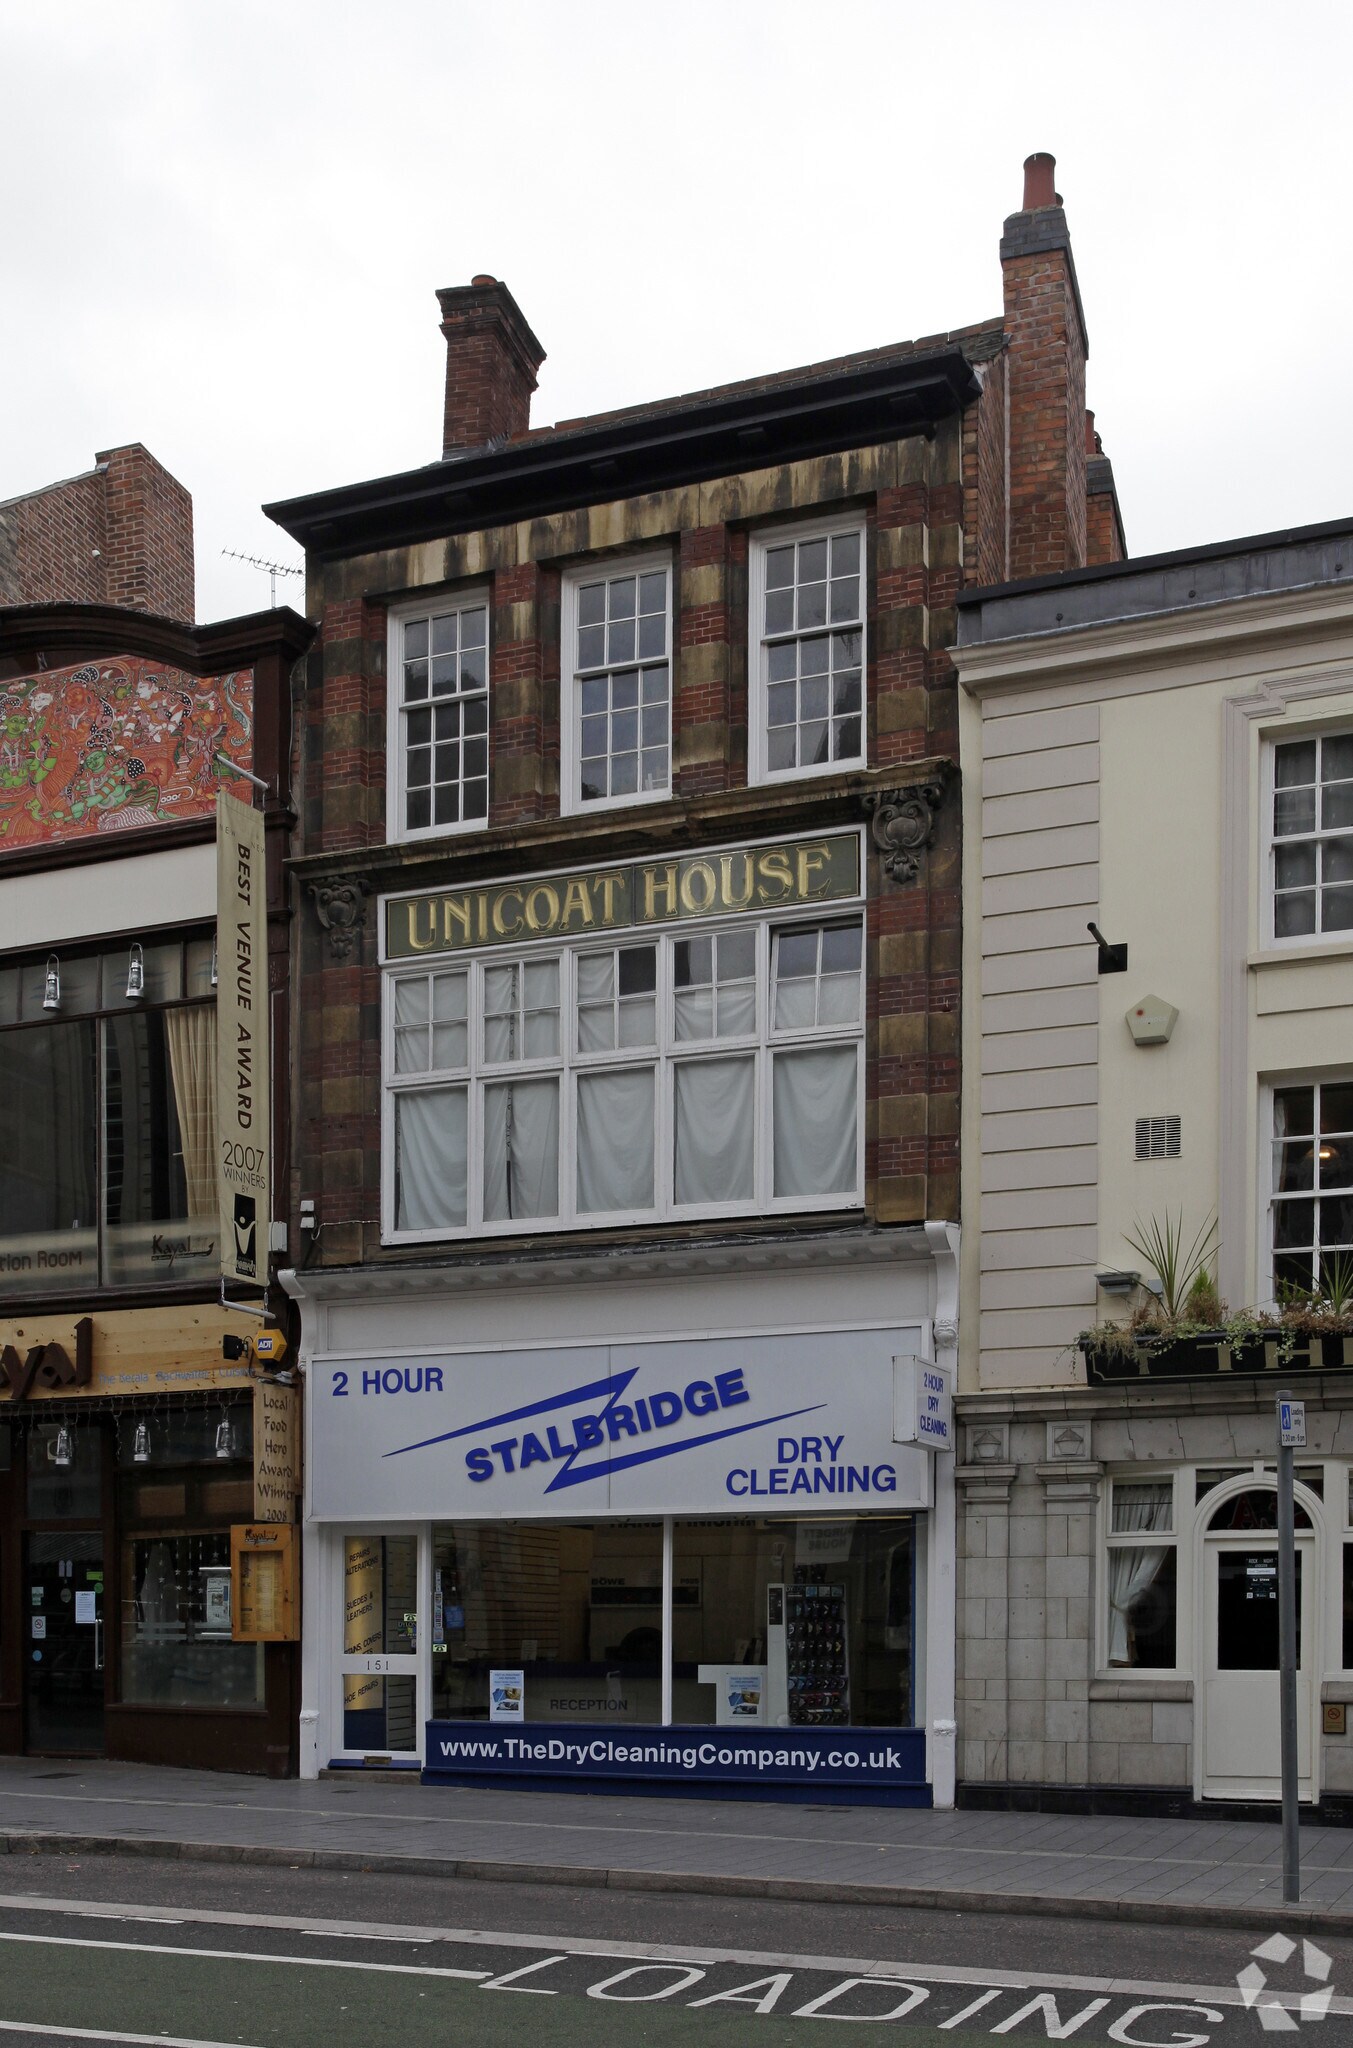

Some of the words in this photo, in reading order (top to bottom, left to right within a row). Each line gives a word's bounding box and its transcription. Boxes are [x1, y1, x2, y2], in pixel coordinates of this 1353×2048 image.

[237, 843, 251, 906] BEST
[406, 872, 626, 951] UNICOAT
[641, 842, 832, 920] HOUSE
[237, 922, 251, 1011] VENUE
[237, 1022, 252, 1130] AWARD
[222, 1140, 264, 1172] 2007
[223, 1166, 266, 1190] WINNERS
[152, 1234, 191, 1267] Kayal
[258, 1338, 273, 1350] ADT
[0, 1317, 93, 1400] yal
[332, 1371, 349, 1396] 2
[362, 1367, 443, 1394] HOUR
[928, 1374, 944, 1393] HOUR
[263, 1393, 288, 1411] Local
[928, 1396, 939, 1412] DRY
[264, 1416, 287, 1433] Food
[465, 1368, 750, 1483] STALBRIDGE
[920, 1415, 947, 1437] CLEANING
[265, 1439, 287, 1455] Hero
[777, 1435, 844, 1464] DRY
[258, 1461, 293, 1477] Award
[726, 1464, 896, 1496] CLEANING
[257, 1483, 296, 1501] Winner
[266, 1508, 287, 1522] 2008
[345, 1555, 379, 1577] ALTERATIONS
[349, 1547, 371, 1563] REPAIRS
[346, 1594, 368, 1611] SUEDES
[346, 1603, 373, 1622] LEATHERS
[363, 1632, 382, 1648] COVERS
[358, 1679, 379, 1696] REPAIRS
[550, 1699, 628, 1711] RECEPTION
[439, 1739, 902, 1770] www.TheDryCleaningCompany.co.uk
[477, 1955, 1225, 2048] LOADING
